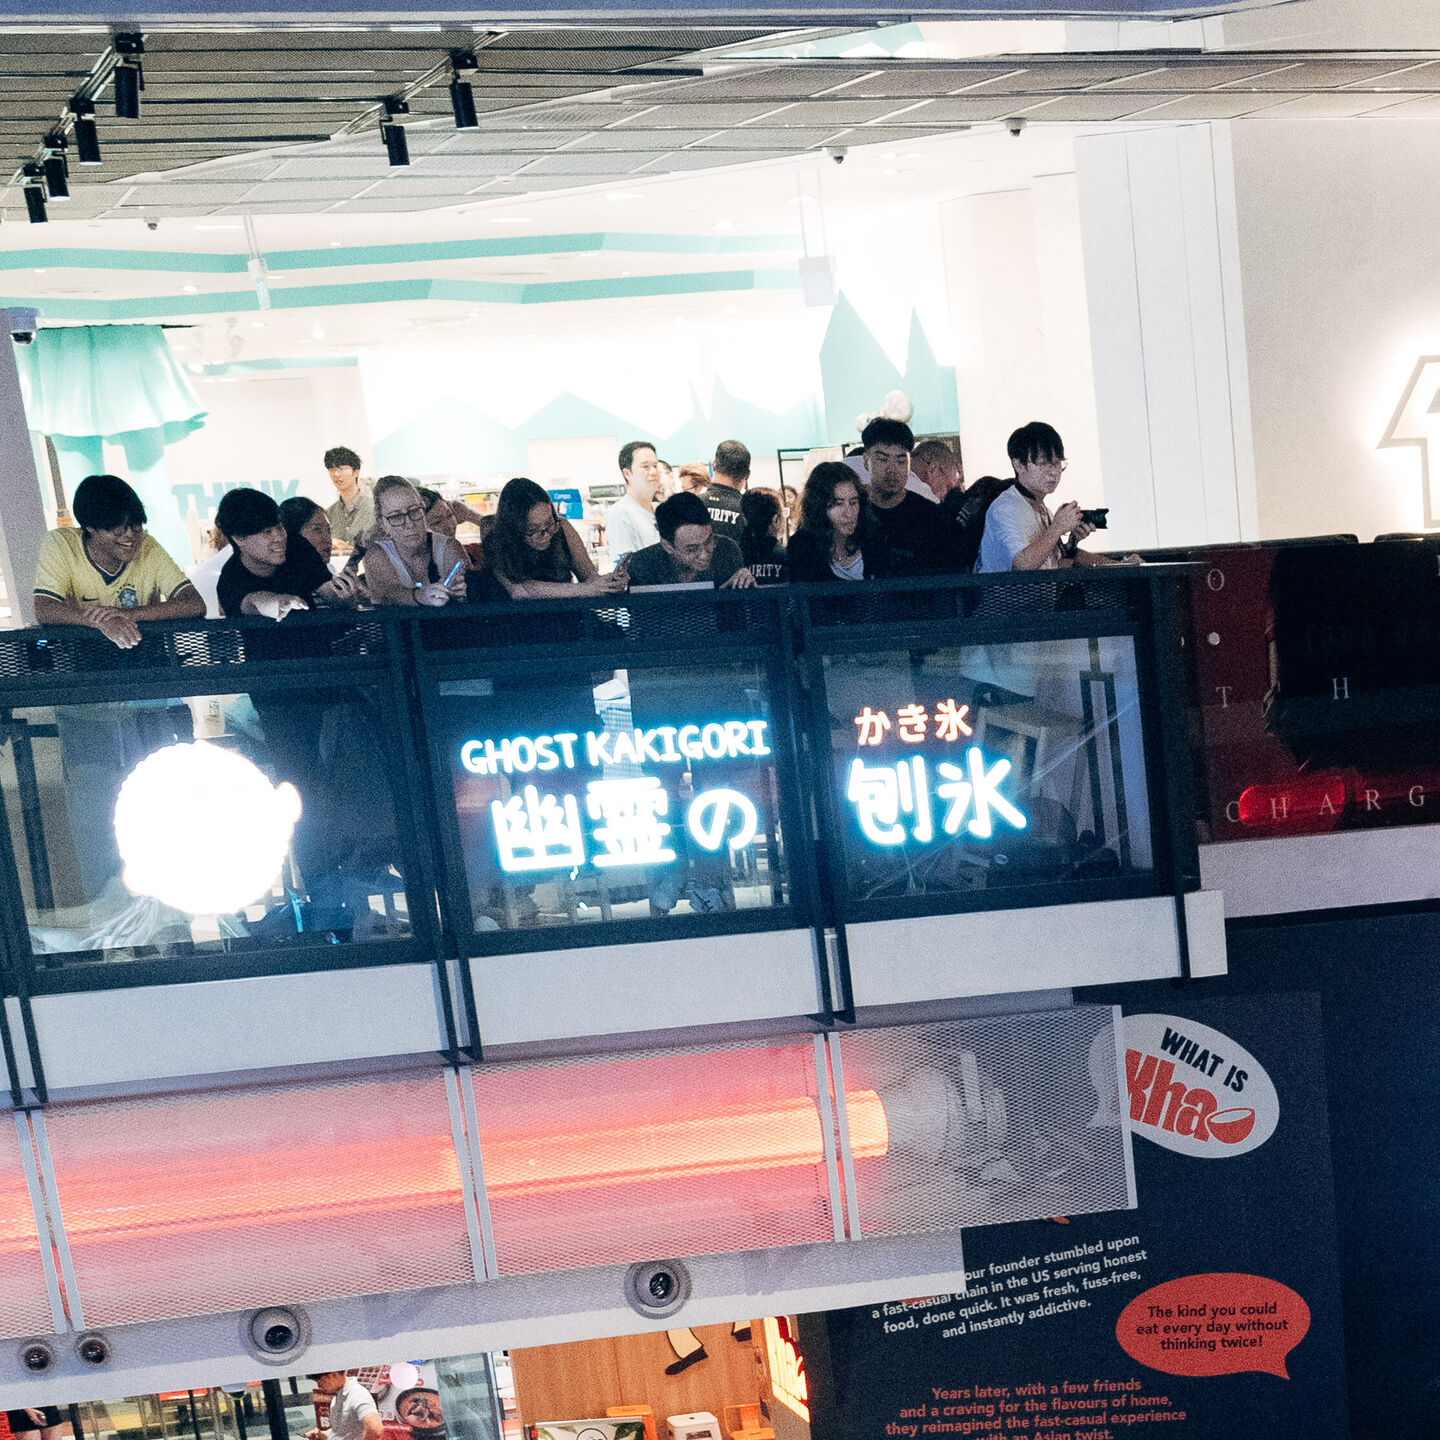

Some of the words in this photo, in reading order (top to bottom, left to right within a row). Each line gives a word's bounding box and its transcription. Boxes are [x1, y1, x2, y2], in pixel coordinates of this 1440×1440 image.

[854, 697, 973, 747] かき氷
[459, 732, 579, 775] GHOST
[585, 719, 772, 767] KAKIGORI
[1160, 1027, 1224, 1078] WHAT
[1223, 1064, 1248, 1093] IS
[989, 1255, 1041, 1276] founder
[1044, 1241, 1104, 1264] stumbled
[1107, 1234, 1140, 1252] upon
[871, 1308, 881, 1319] a
[883, 1292, 952, 1317] fast-casual
[954, 1281, 988, 1301] chain
[991, 1280, 1003, 1293] in
[1006, 1273, 1029, 1290] the
[1031, 1267, 1050, 1284] US
[1053, 1261, 1102, 1282] serving
[1103, 1249, 1148, 1269] honest
[883, 1317, 920, 1334] food,
[922, 1308, 956, 1326] done
[959, 1300, 998, 1323] quick.
[1000, 1295, 1011, 1308] It
[1014, 1292, 1040, 1306] was
[1042, 1281, 1080, 1300] fresh,
[1082, 1269, 1142, 1291] fuss-free,
[942, 1322, 968, 1339] and
[969, 1310, 1025, 1334] instantly
[1028, 1298, 1092, 1321] addictive.
[1136, 1322, 1159, 1335] eat
[1163, 1323, 1203, 1337] every
[1206, 1320, 1231, 1336] day
[1235, 1319, 1289, 1332] without
[1147, 1305, 1173, 1318] The
[1177, 1303, 1207, 1318] kind
[1211, 1305, 1236, 1320] you
[1240, 1302, 1277, 1316] could
[1160, 1337, 1217, 1352] thinking
[1221, 1335, 1264, 1348] twice!
[899, 1404, 926, 1419] and
[931, 1407, 940, 1417] a
[943, 1402, 995, 1419] craving
[999, 1399, 1020, 1414] for
[1024, 1399, 1047, 1412] the
[1052, 1396, 1108, 1411] flavours
[1112, 1394, 1128, 1407] of
[1131, 1392, 1173, 1408] home,
[932, 1386, 971, 1401] Years
[974, 1384, 1011, 1400] later,
[1015, 1382, 1046, 1397] with
[1050, 1385, 1059, 1395] a
[1062, 1380, 1089, 1395] few
[1093, 1377, 1142, 1392] friends
[885, 1421, 918, 1438] they
[922, 1418, 1003, 1436] reimagined
[1006, 1415, 1030, 1429] the
[1034, 1412, 1107, 1429] fast-casual
[1110, 1408, 1187, 1427] experience
